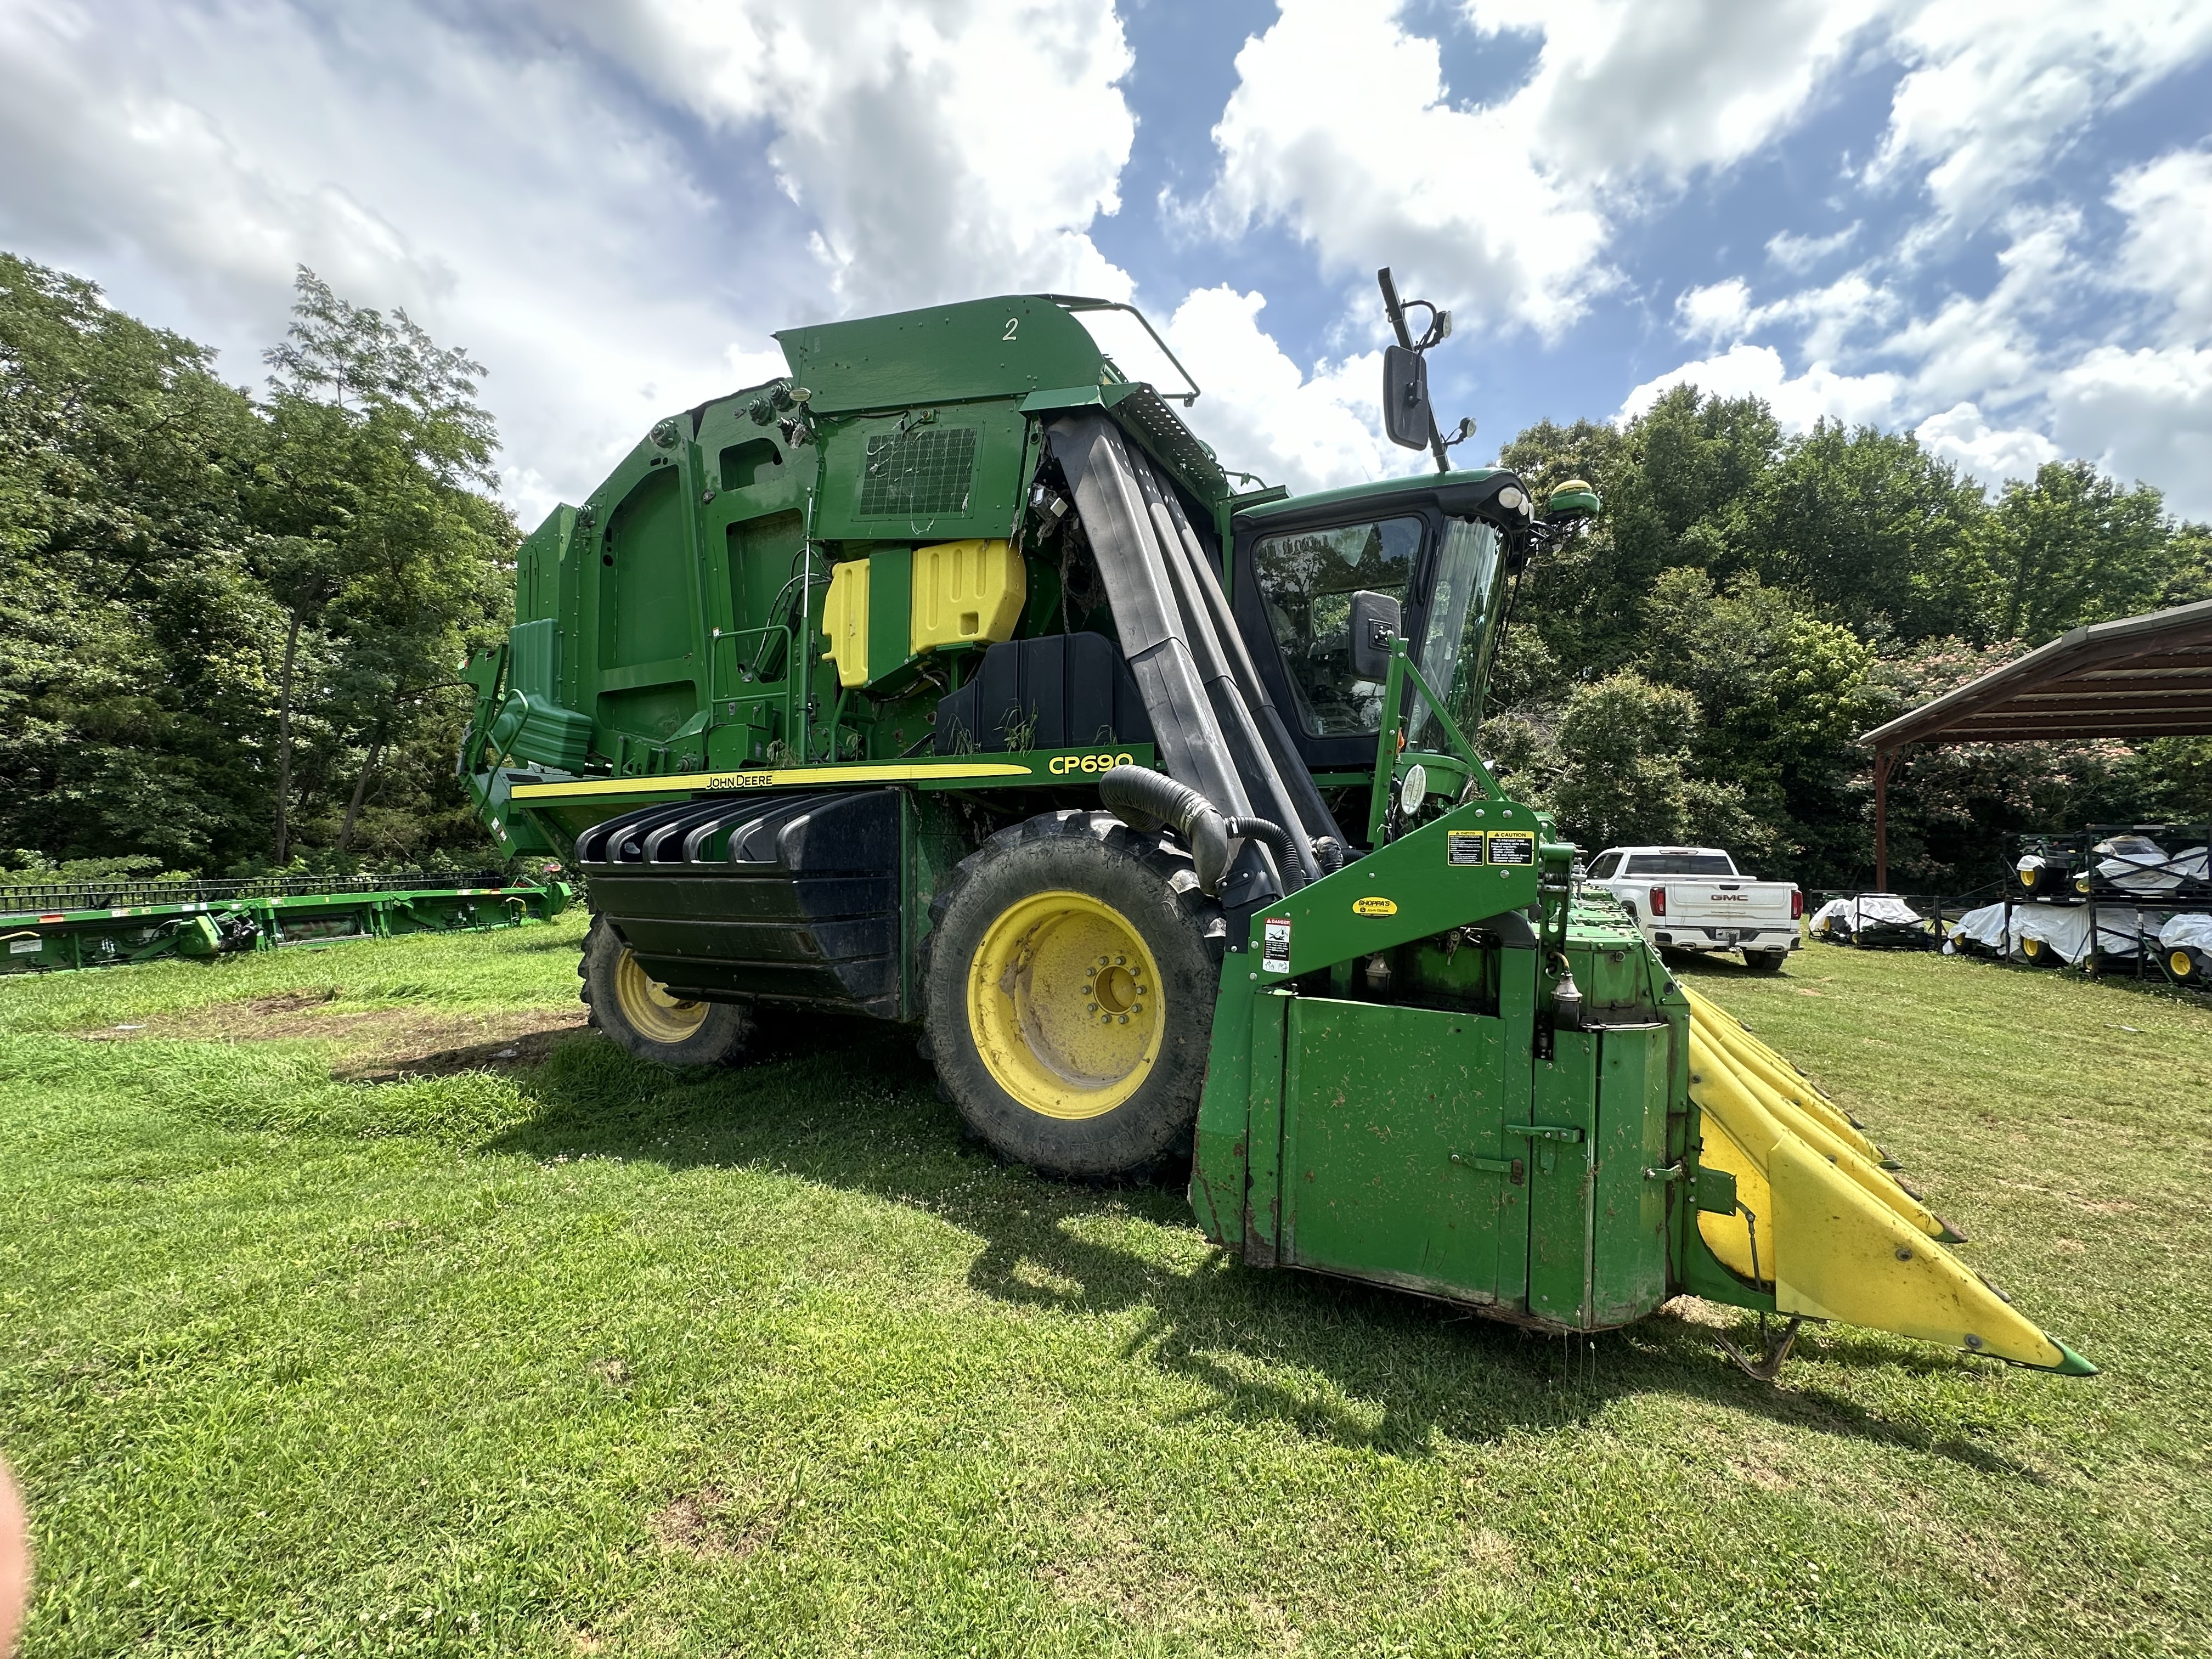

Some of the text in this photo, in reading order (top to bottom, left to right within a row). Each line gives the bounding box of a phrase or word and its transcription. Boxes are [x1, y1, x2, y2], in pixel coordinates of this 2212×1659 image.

[1002, 318, 1018, 341] 2
[1049, 753, 1134, 775] CP690
[707, 775, 772, 788] JOHN DEERE
